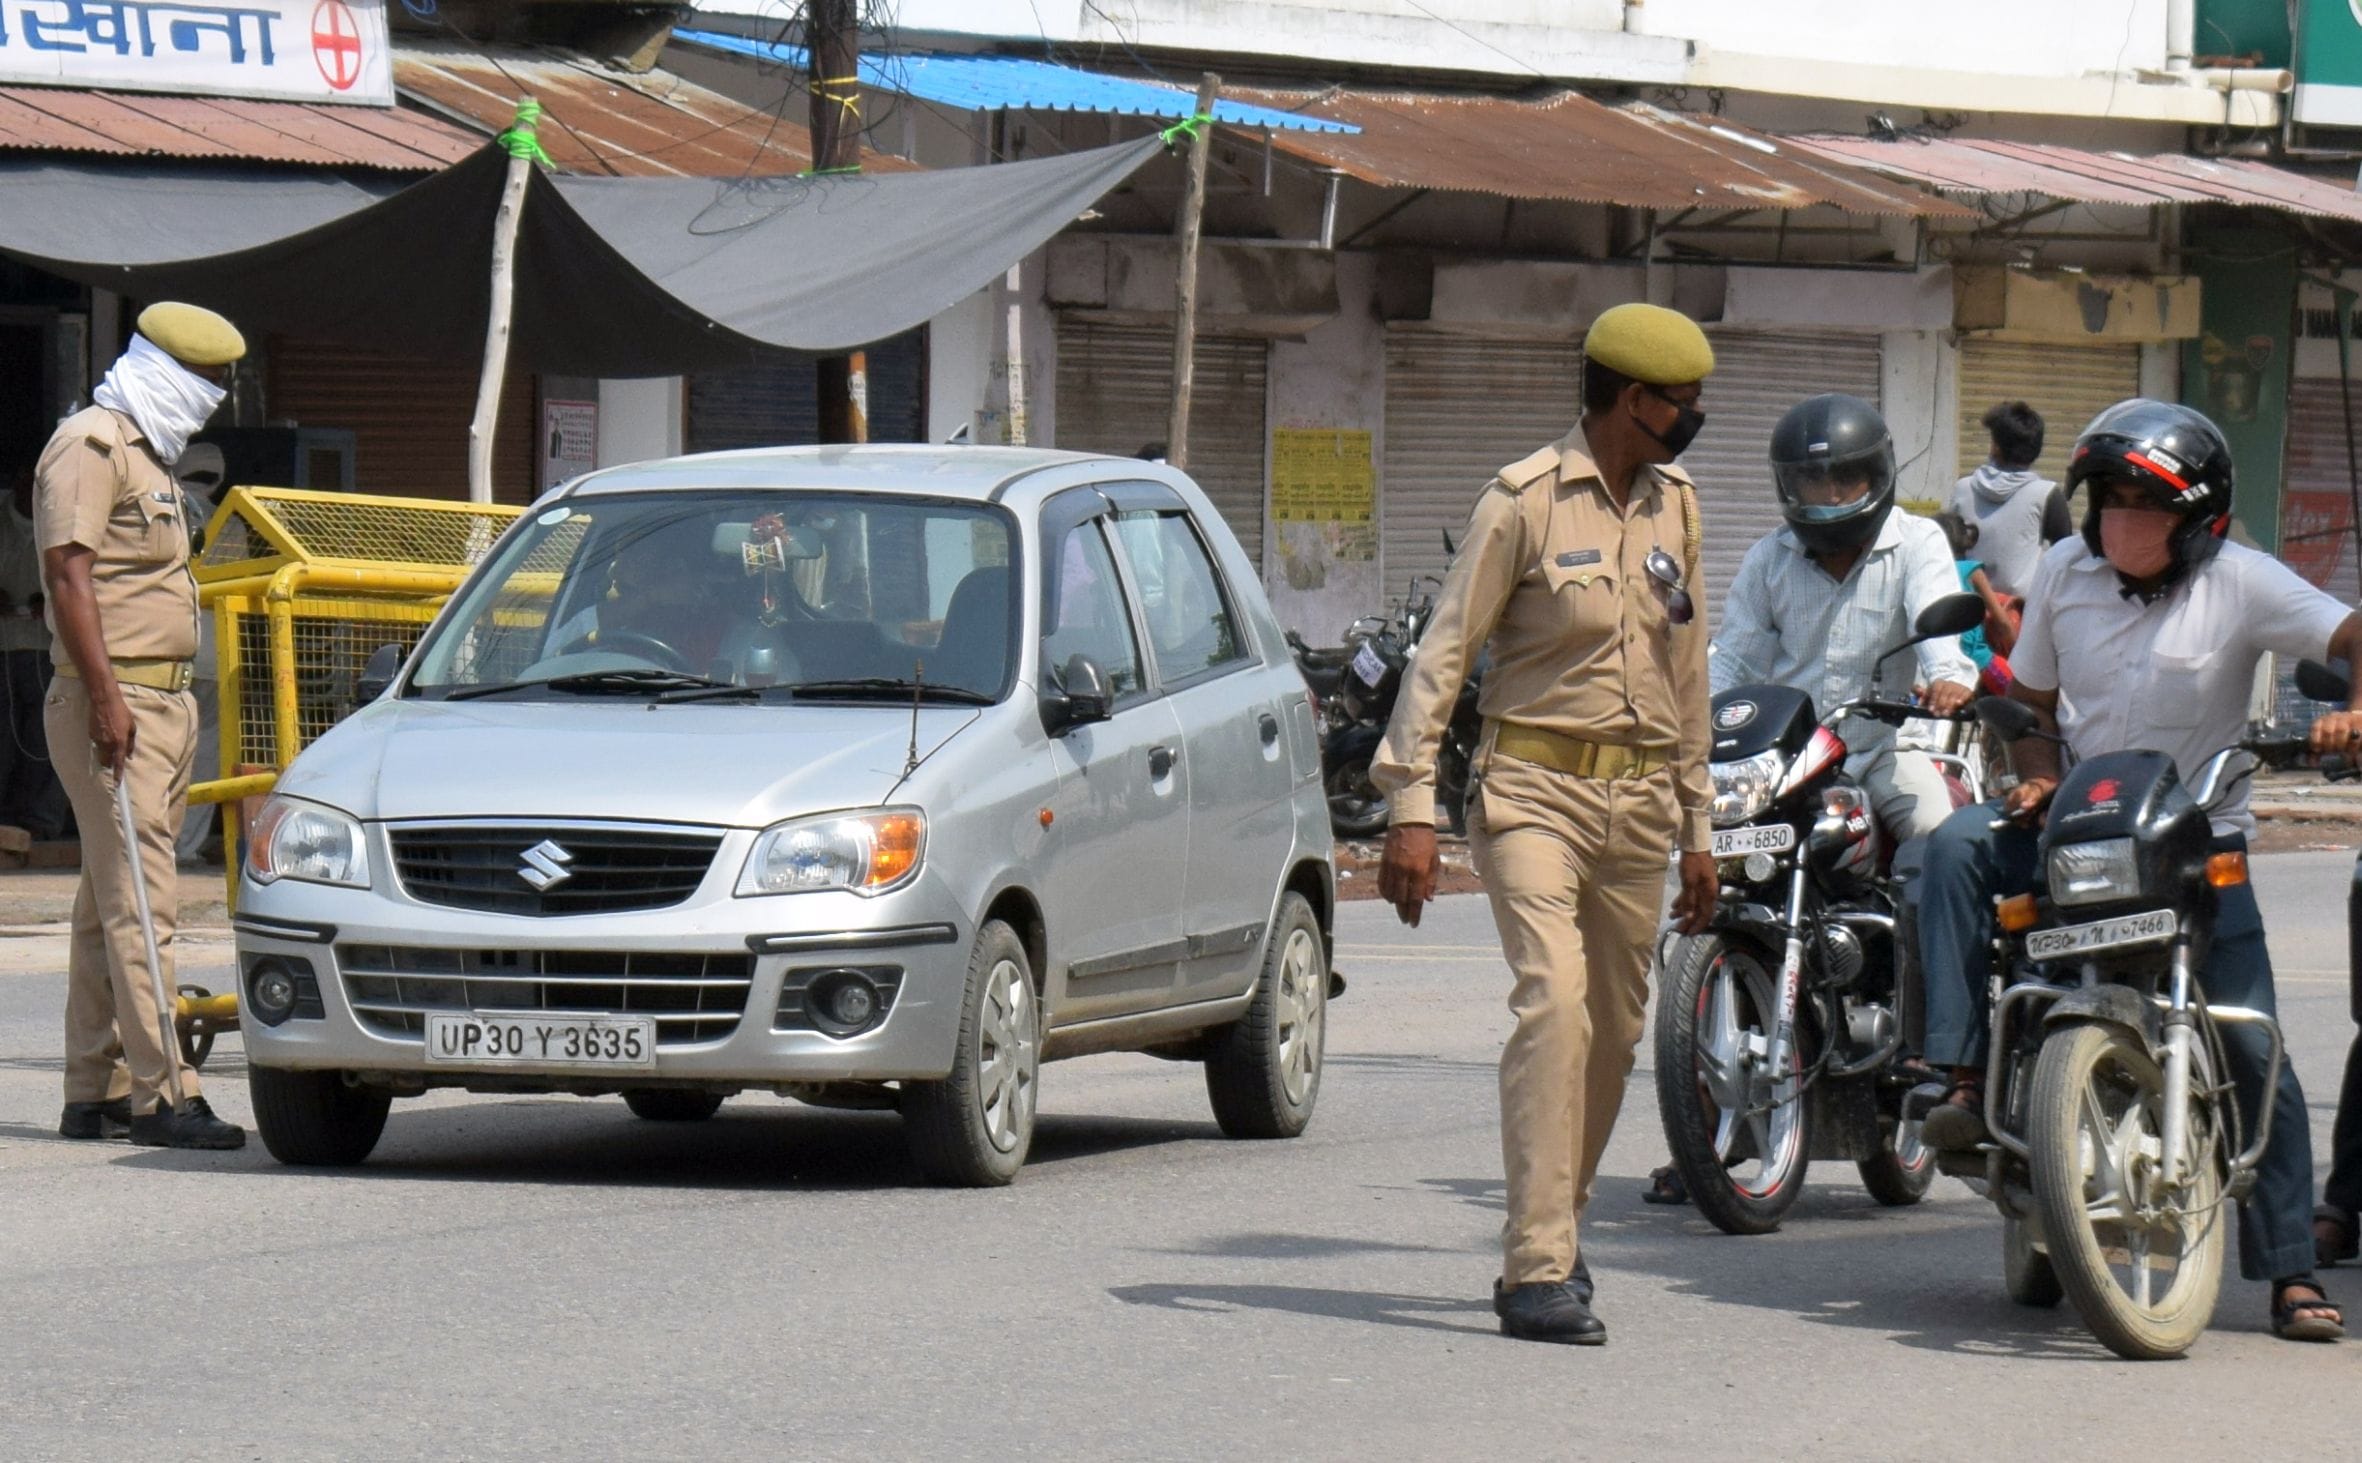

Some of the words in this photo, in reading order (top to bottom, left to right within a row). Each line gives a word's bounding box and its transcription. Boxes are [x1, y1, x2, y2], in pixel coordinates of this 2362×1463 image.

[0, 0, 282, 66] खाना
[1754, 829, 1788, 850] 6850
[441, 1023, 523, 1056] UP30
[536, 1025, 552, 1058] Y
[563, 1026, 642, 1060] 3635
